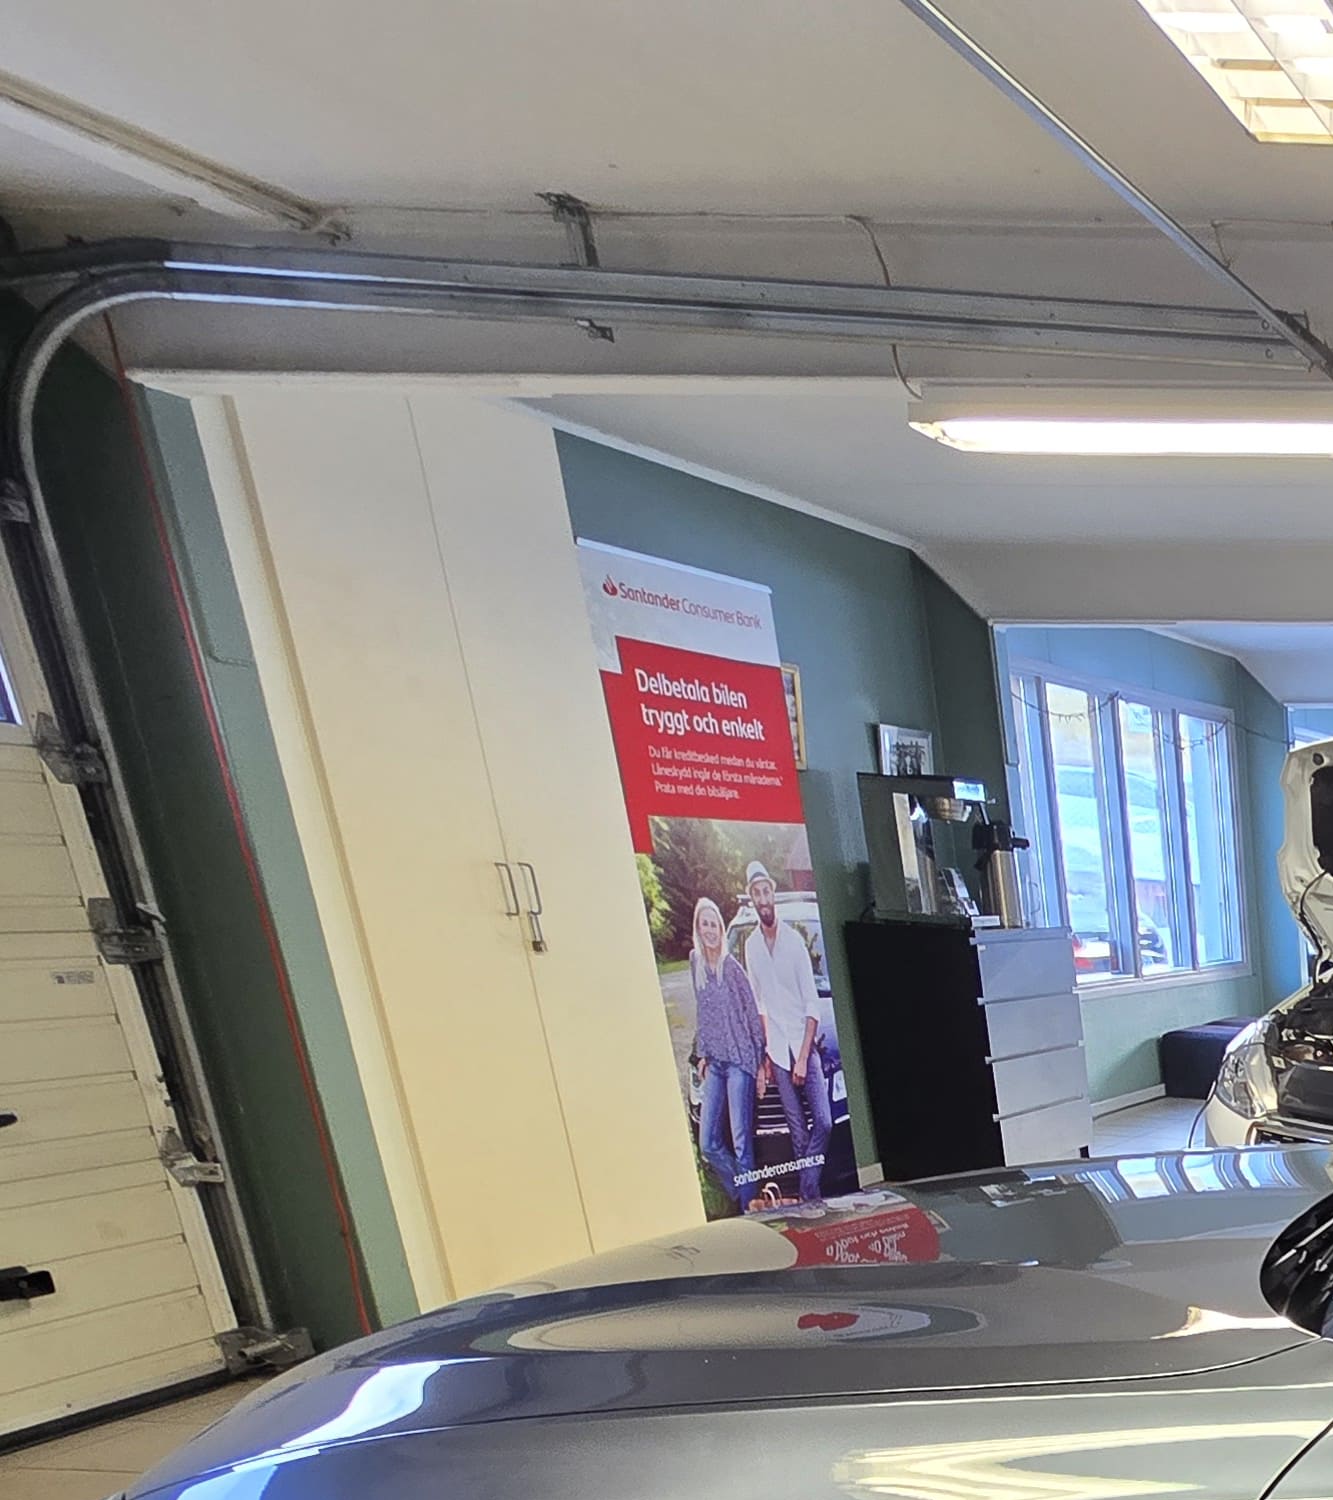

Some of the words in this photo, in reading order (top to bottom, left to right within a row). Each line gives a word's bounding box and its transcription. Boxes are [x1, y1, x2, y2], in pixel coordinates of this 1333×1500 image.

[618, 582, 680, 610] Santander
[681, 598, 735, 624] Consumer
[736, 610, 762, 629] Bank
[634, 668, 711, 703] Delbetala
[711, 681, 748, 709] bilen
[640, 703, 690, 736] tryggt
[693, 712, 720, 735] och
[721, 716, 766, 741] enkelt
[733, 1154, 825, 1187] santanderconsumer.se
